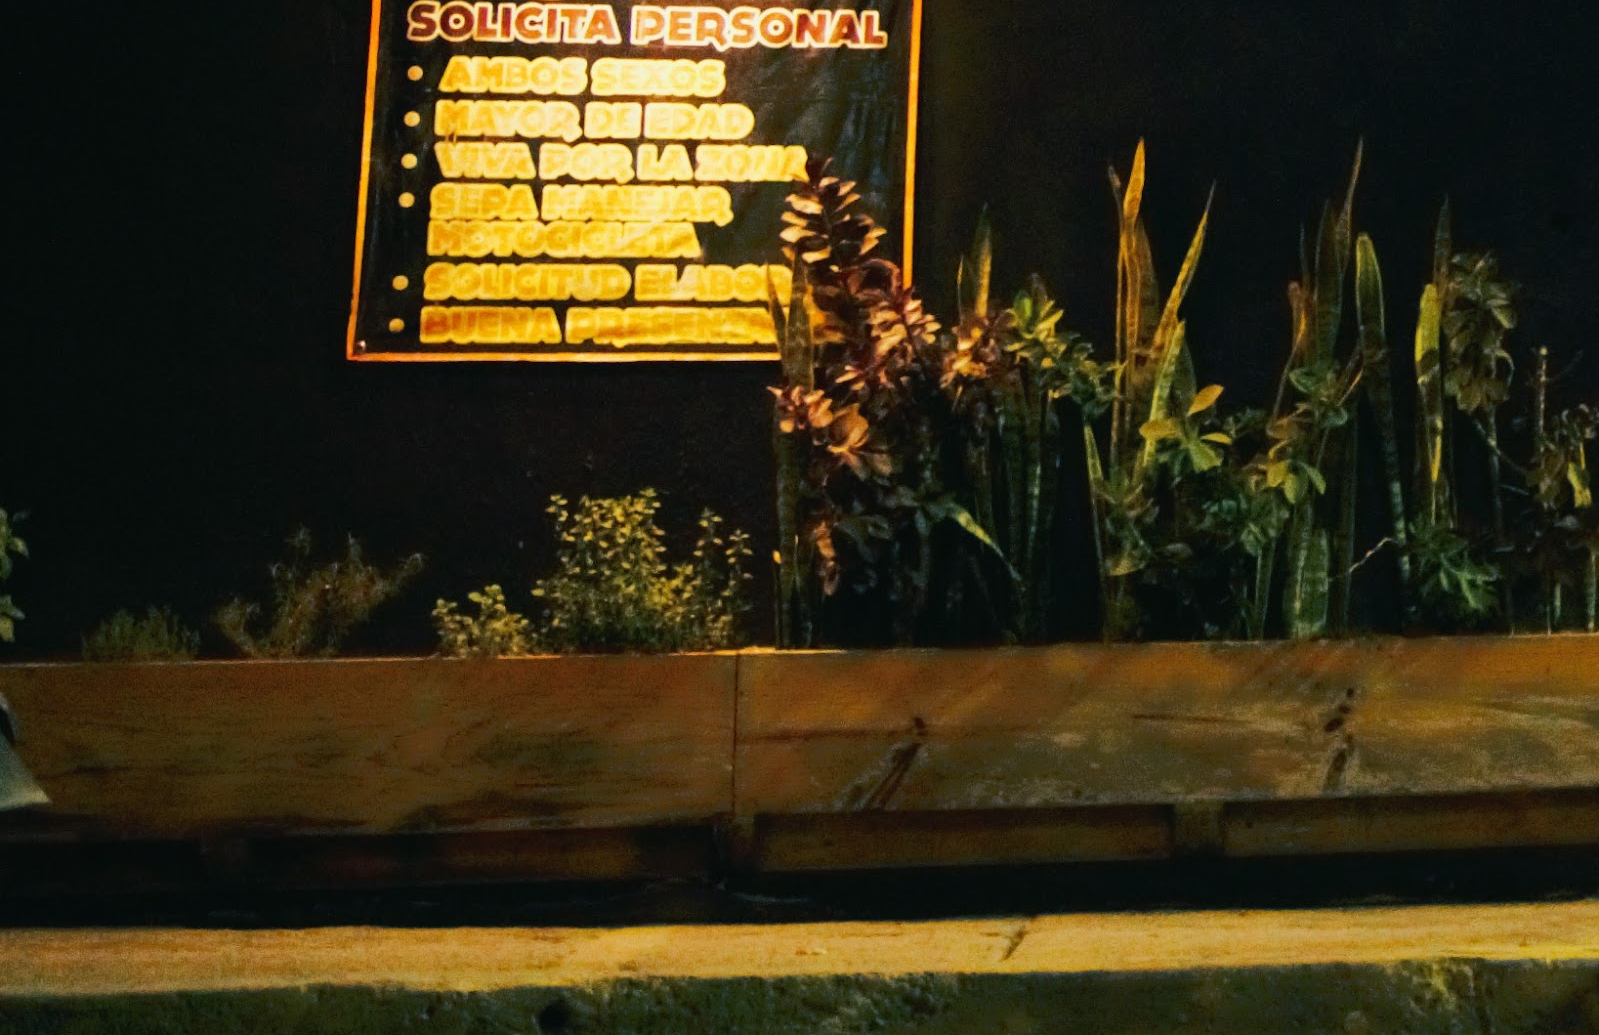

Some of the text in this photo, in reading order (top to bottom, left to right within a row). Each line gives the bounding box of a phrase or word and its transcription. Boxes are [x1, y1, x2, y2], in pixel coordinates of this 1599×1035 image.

[407, 0, 888, 52] SOLICITA PERSONAL
[438, 55, 727, 97] AMBOS SEXOS
[434, 99, 755, 143] MAYOR DE EDAD
[538, 142, 635, 184] POR
[636, 143, 694, 181] LA
[430, 181, 539, 221] SEPA
[423, 262, 632, 301] SOLICITUD
[420, 306, 562, 344] BUENA
